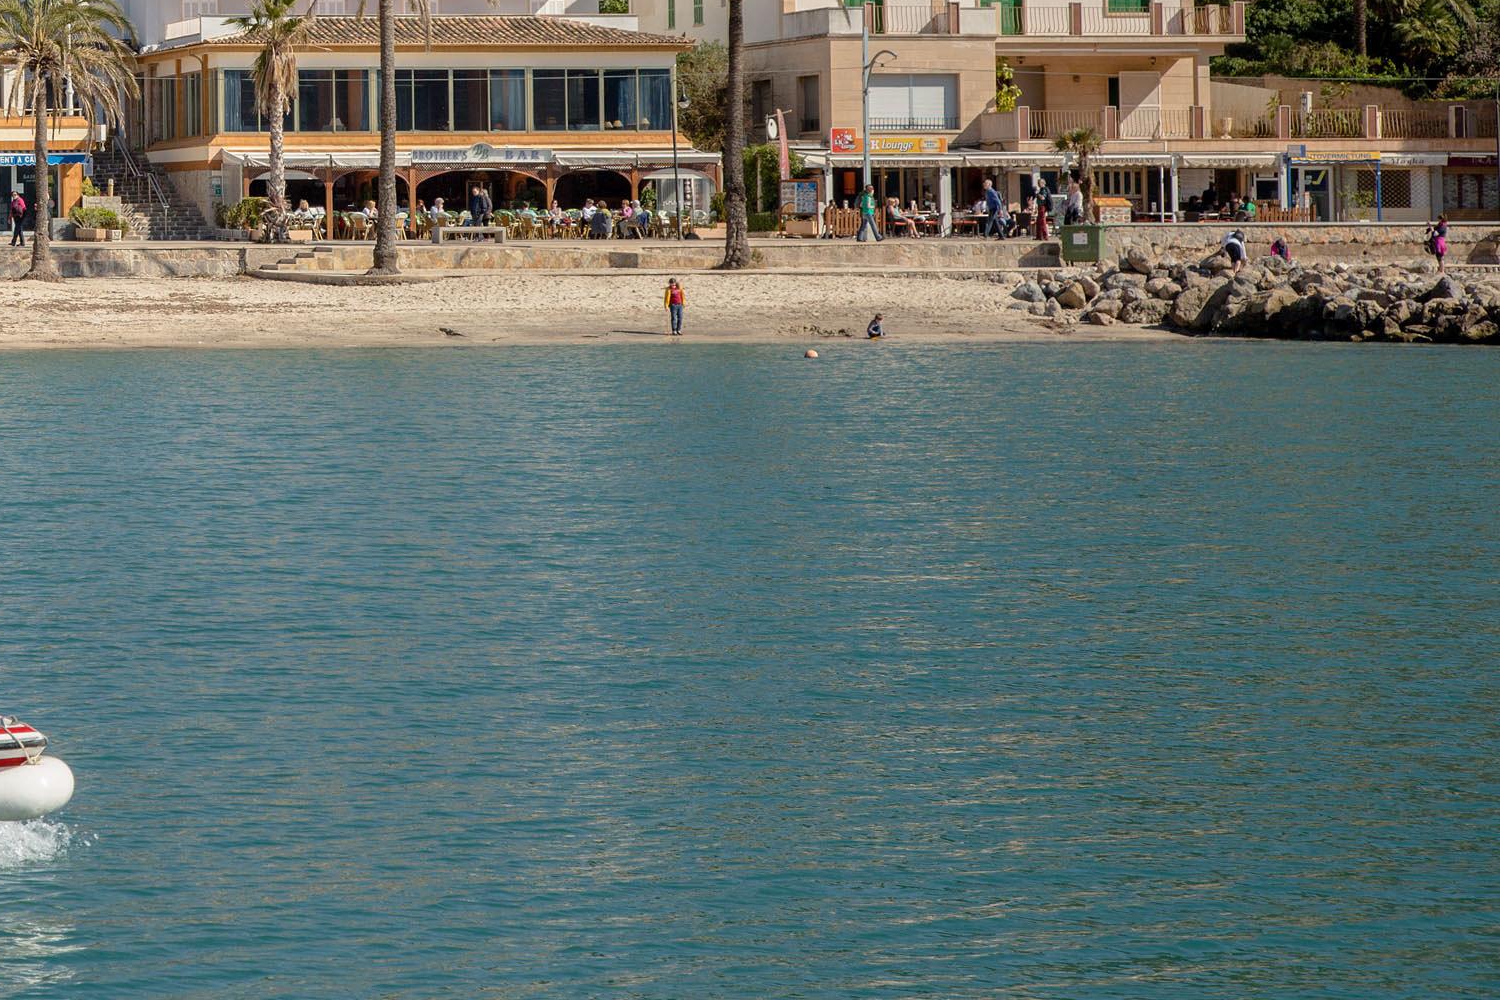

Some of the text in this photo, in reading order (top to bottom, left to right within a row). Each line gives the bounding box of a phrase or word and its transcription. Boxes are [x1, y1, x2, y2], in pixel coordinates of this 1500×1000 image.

[881, 138, 914, 152] Lounge
[17, 156, 23, 164] A
[24, 156, 37, 164] CA
[412, 150, 540, 161] BROTHER'S BAR
[1306, 152, 1372, 160] UTOVERMIETUNG
